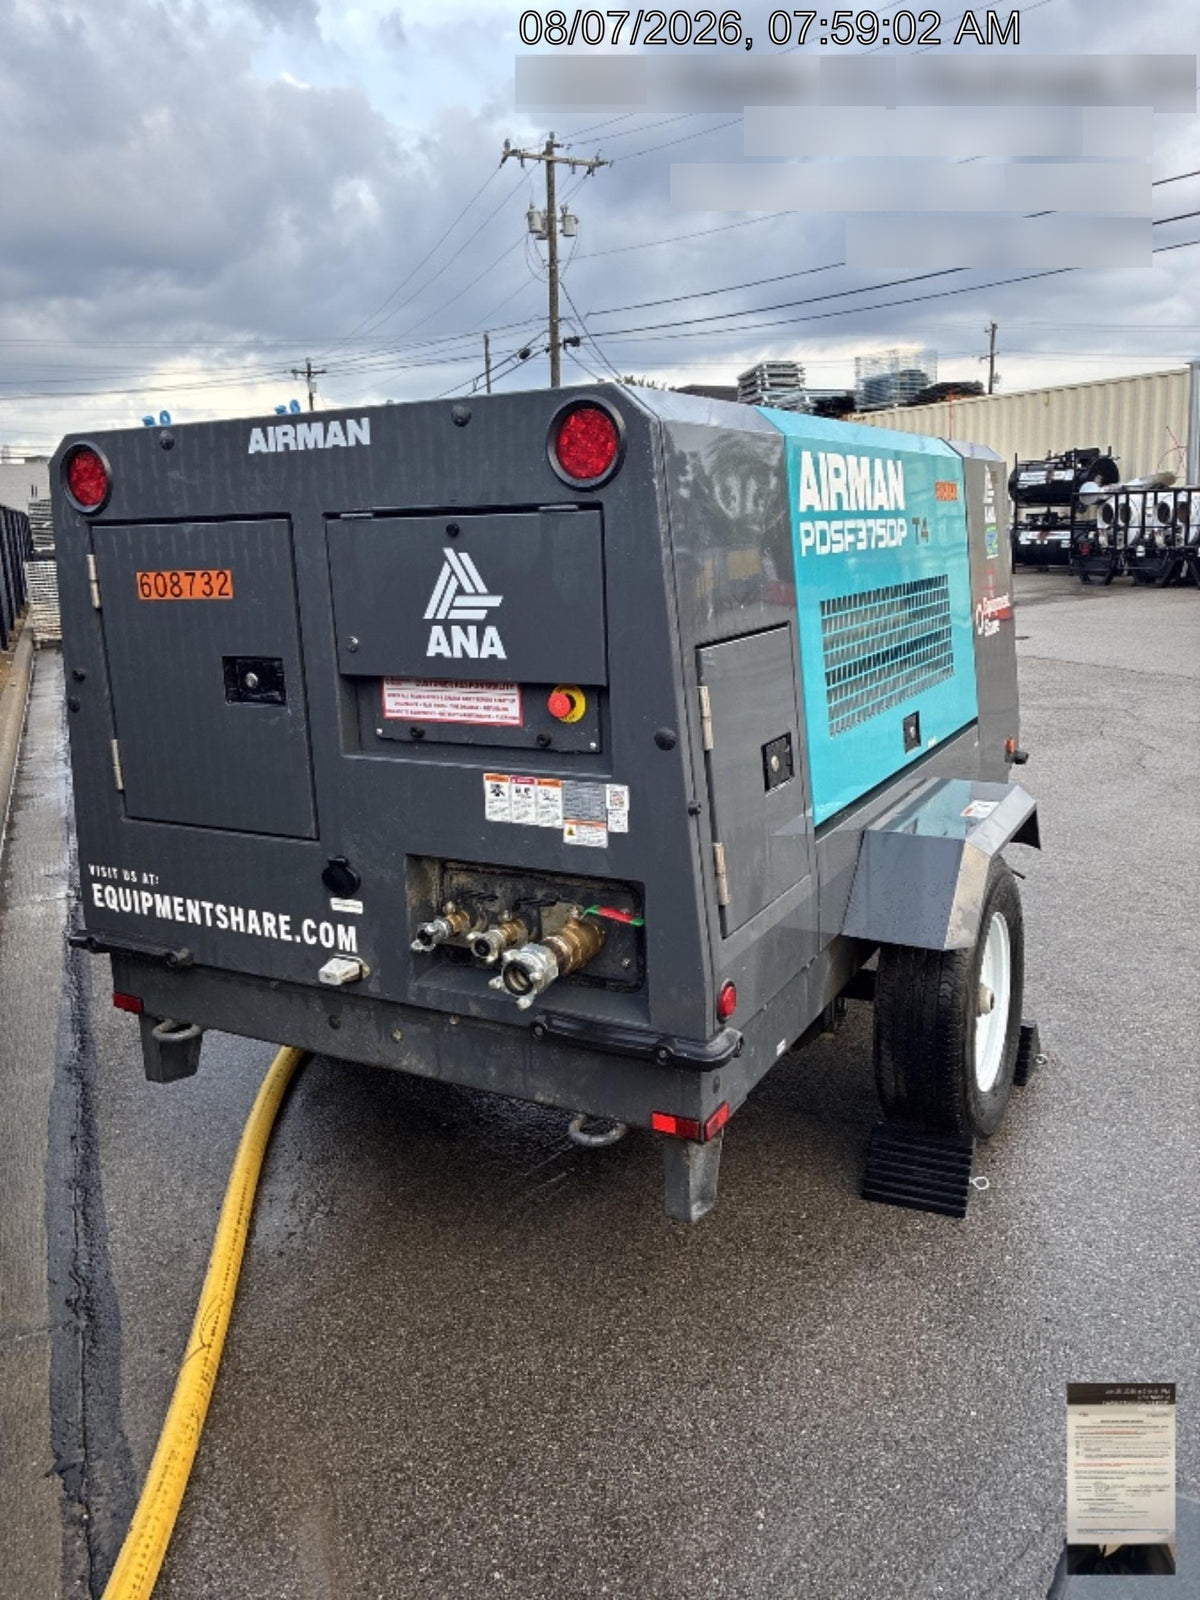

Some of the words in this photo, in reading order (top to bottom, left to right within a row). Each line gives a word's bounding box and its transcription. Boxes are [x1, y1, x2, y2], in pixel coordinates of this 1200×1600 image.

[248, 417, 370, 454] AIRMAN
[799, 450, 906, 513] AIRMAN
[800, 517, 908, 557] PDSF375DP
[139, 570, 231, 598] 608732
[426, 625, 508, 659] ANA
[88, 864, 118, 880] VISIT
[123, 869, 138, 883] US
[142, 872, 160, 886] AT:
[91, 882, 358, 954] EQUIPMENTSHARE.COM
